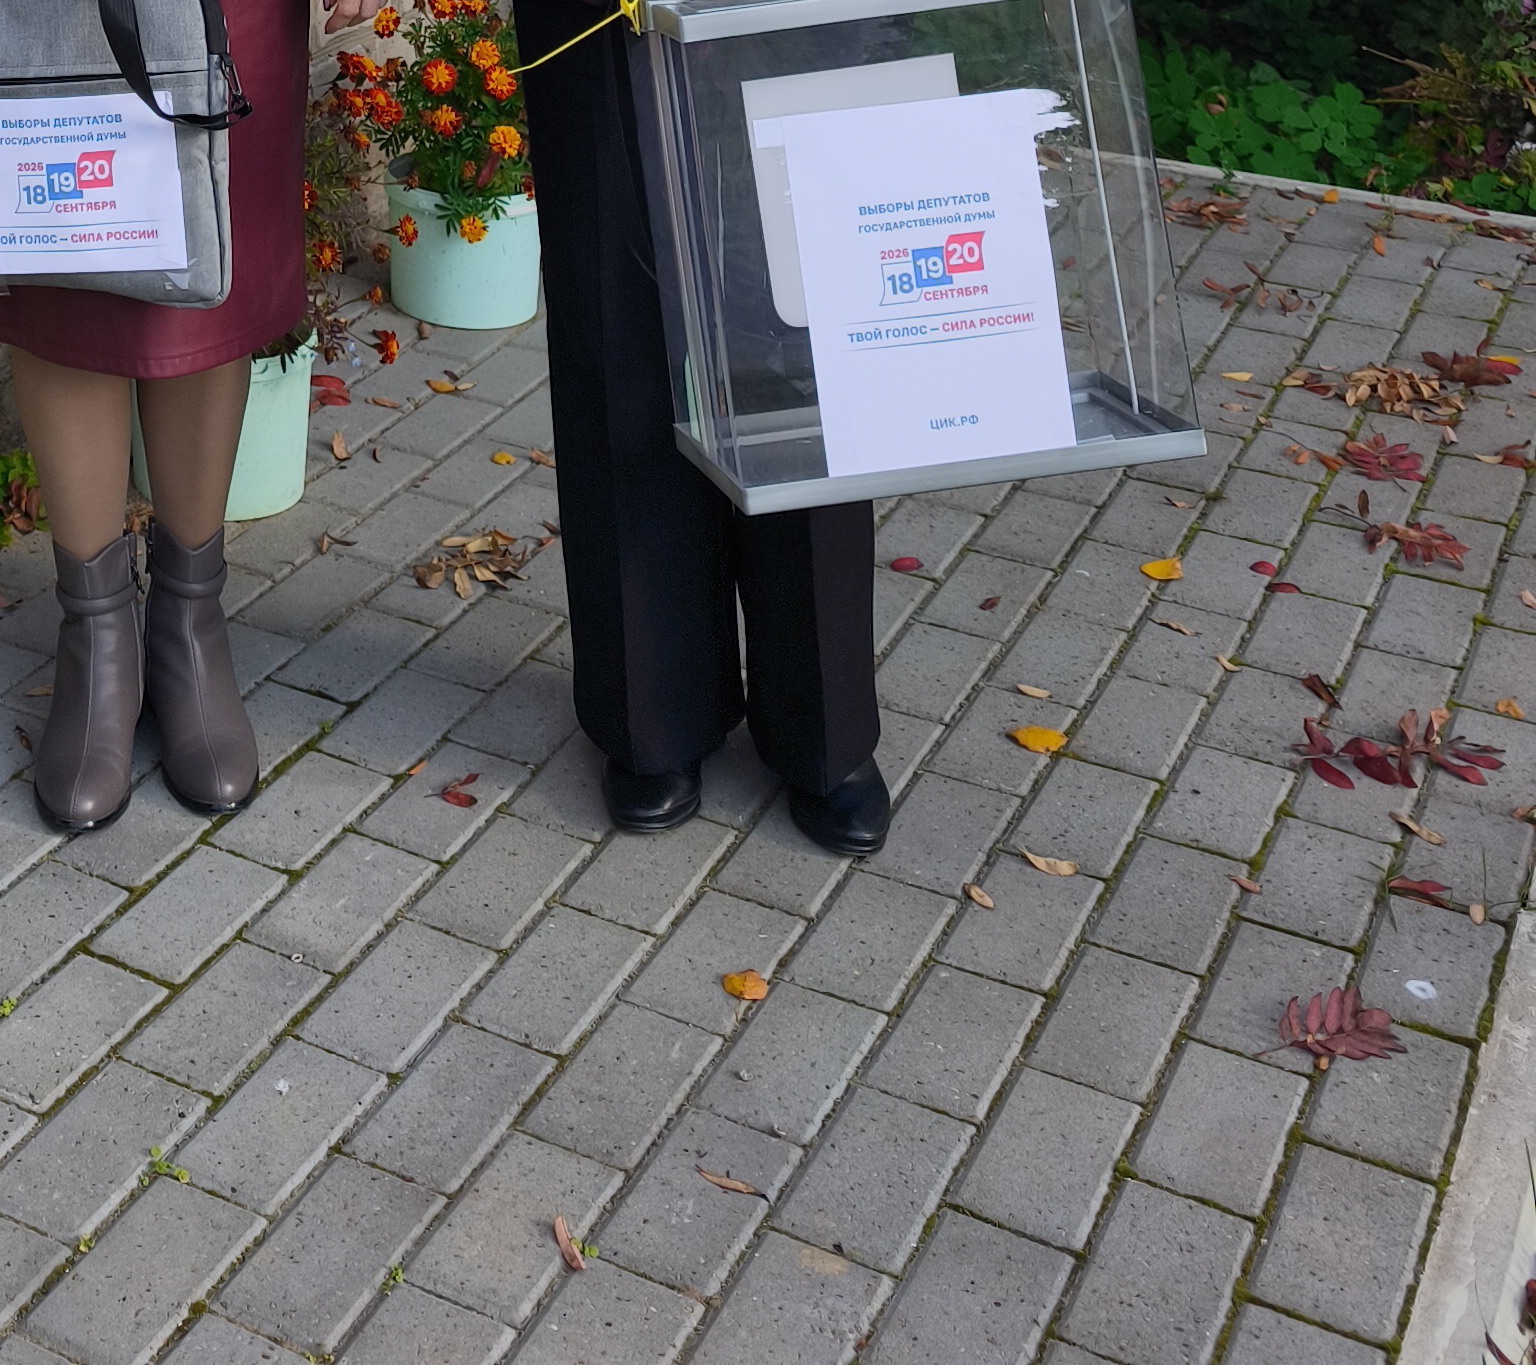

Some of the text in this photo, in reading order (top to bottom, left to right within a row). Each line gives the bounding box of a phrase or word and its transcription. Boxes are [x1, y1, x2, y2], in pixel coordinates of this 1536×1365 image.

[1, 113, 123, 130] ВЫБОРЫ ДЕПУТАТОВ
[0, 131, 127, 146] ГОСУДАРСТВЕННОЙ ДУМЫ
[22, 160, 110, 205] 18 19 20
[55, 200, 117, 214] СЕНТЯБРЯ
[859, 192, 991, 216] ВЫБОРЫ ДЕПУТАТОВ
[858, 210, 996, 234] ГОСУДАРСТВЕННОЙ ДУМЫ
[19, 234, 58, 245] ГОЛОС
[70, 232, 104, 244] СИЛА
[106, 229, 159, 242] РОССИИ!
[880, 248, 909, 260] 2026
[886, 241, 980, 295] 18 19 20
[923, 285, 989, 302] СЕНТЯБРЯ
[848, 329, 883, 343] ТВОЙ
[885, 325, 928, 339] ГОЛОС
[941, 320, 977, 332] СИЛА
[979, 312, 1035, 329] РОССИИ!
[930, 414, 979, 431] ЦИК.РФ
